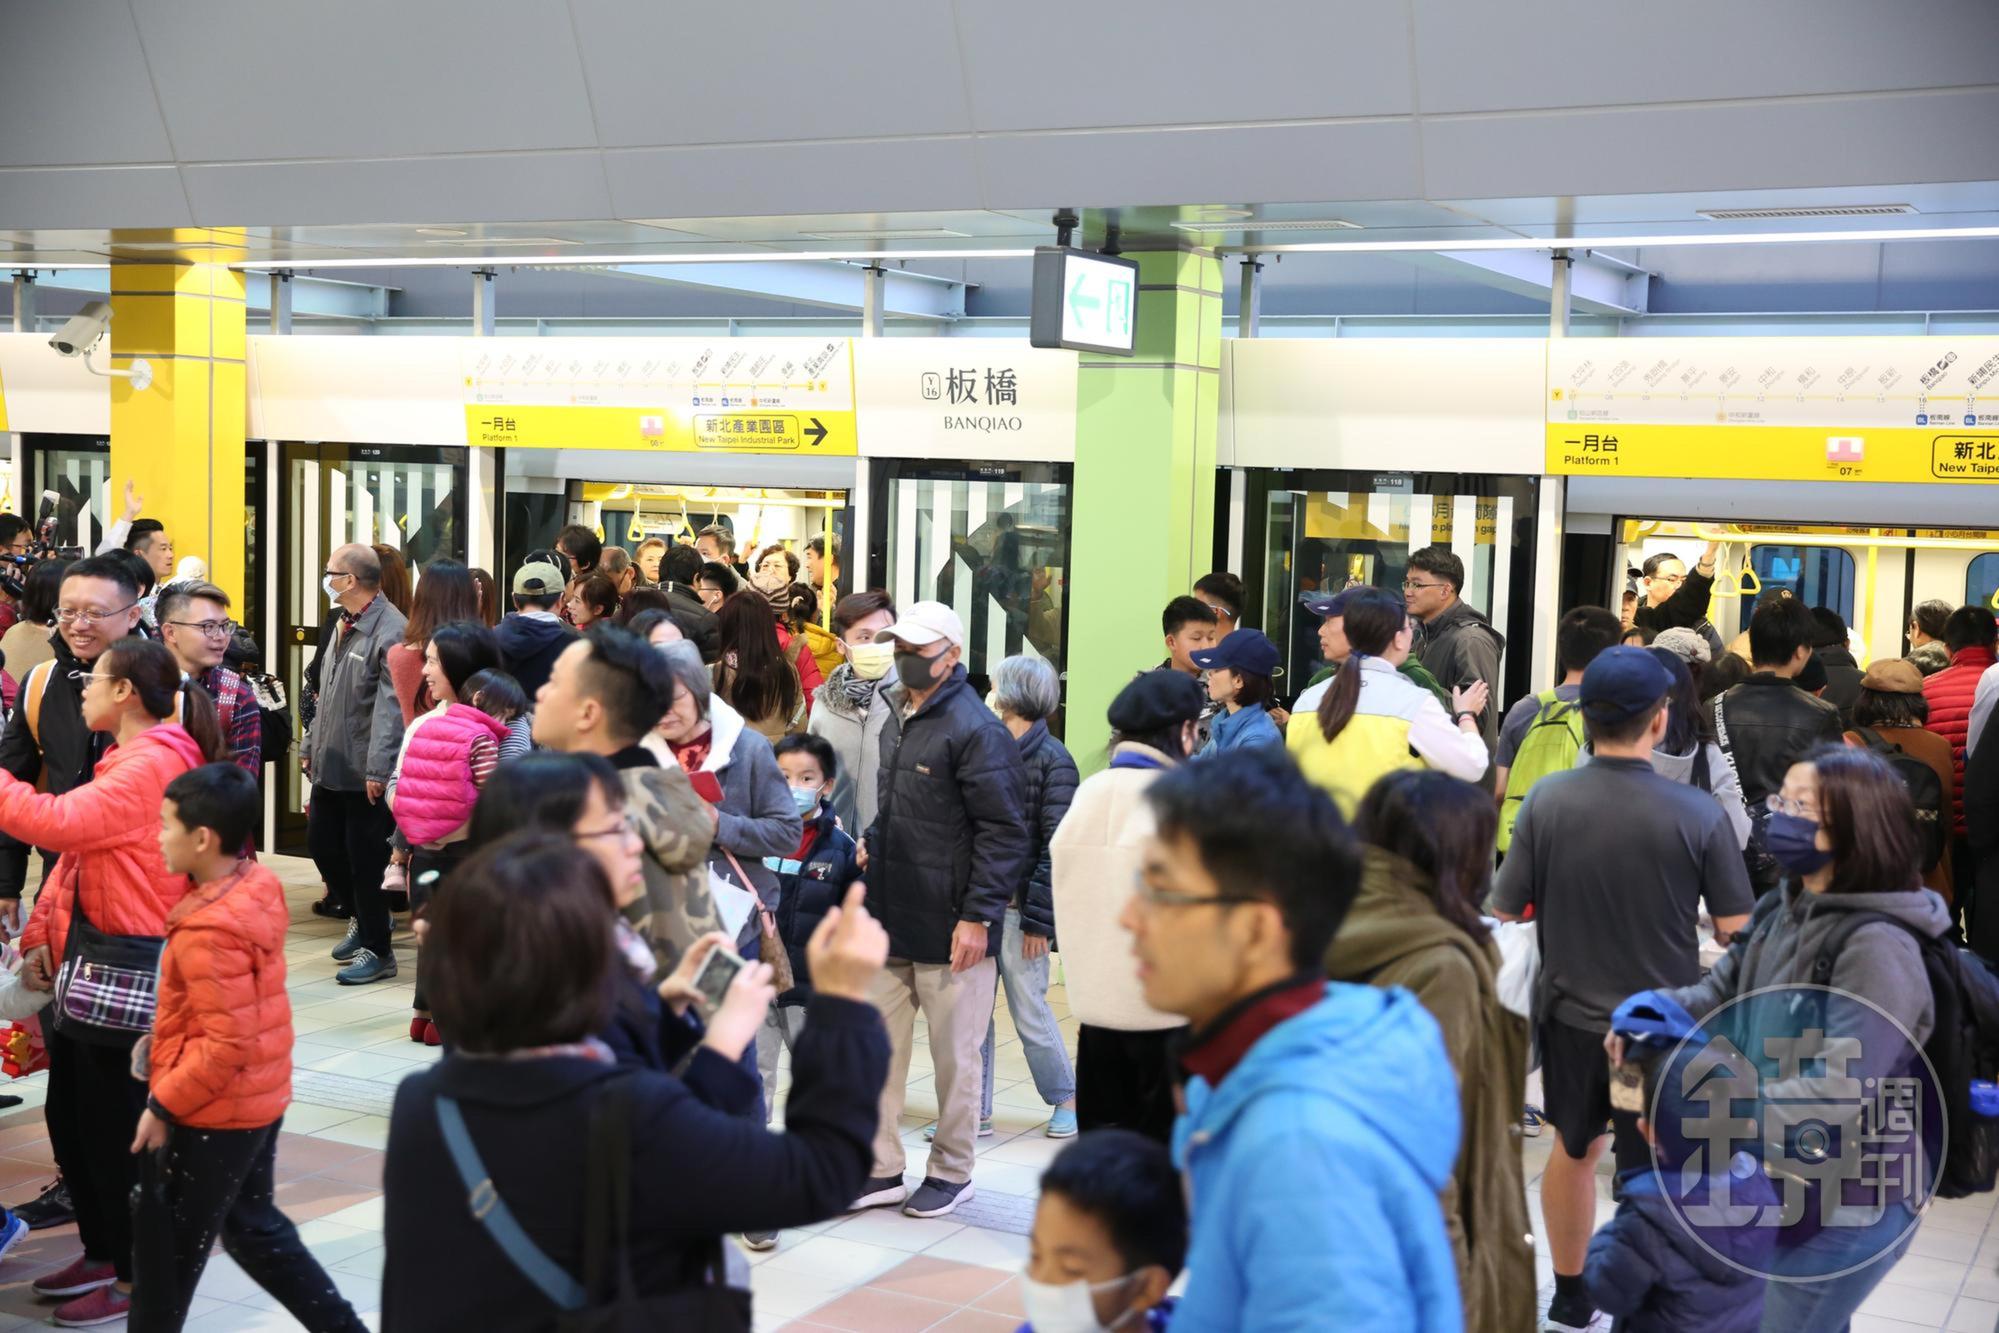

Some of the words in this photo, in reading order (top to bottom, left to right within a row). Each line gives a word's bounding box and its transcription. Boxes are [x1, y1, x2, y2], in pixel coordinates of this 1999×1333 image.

[927, 377, 934, 385] Y
[945, 367, 1018, 406] 板橋
[925, 387, 938, 397] 16
[481, 416, 516, 431] 一月台
[706, 417, 785, 435] 新北產業園區
[944, 416, 1023, 433] BANQIAO
[482, 433, 512, 442] Platform
[699, 434, 715, 444] New
[717, 435, 739, 446] Taipei
[741, 435, 773, 446] Industrial
[776, 436, 795, 446] Park
[1564, 434, 1619, 453] 一月台
[1954, 441, 1999, 460] 新北
[1564, 456, 1611, 466] Platform
[1840, 467, 1852, 475] 07
[1939, 463, 1967, 474] New
